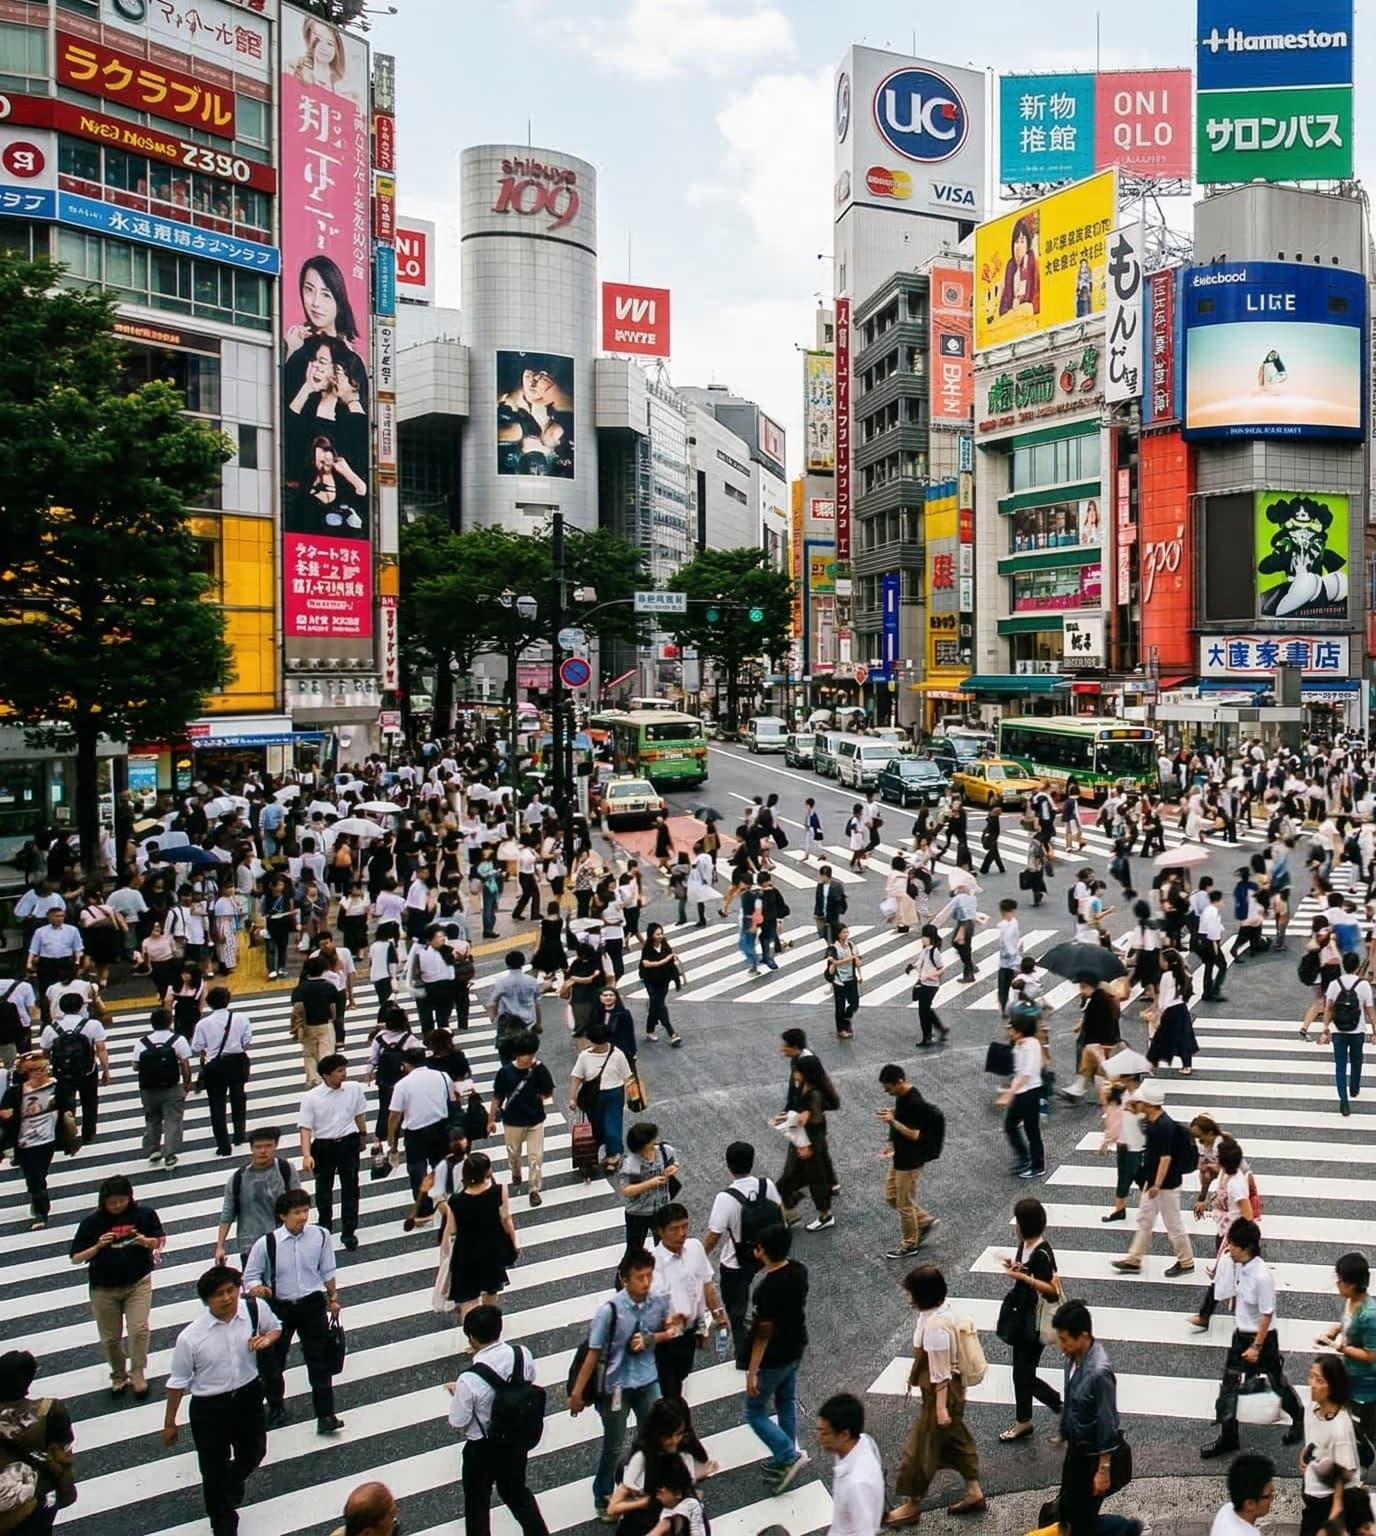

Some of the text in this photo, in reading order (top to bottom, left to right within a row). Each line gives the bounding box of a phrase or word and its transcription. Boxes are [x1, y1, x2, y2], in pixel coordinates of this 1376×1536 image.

[65, 44, 232, 127] ラクラブル
[885, 88, 957, 141] UC
[1019, 91, 1077, 121] 新物
[1113, 90, 1168, 116] ONI
[1113, 122, 1173, 150] QLO
[491, 177, 579, 230] 109
[933, 183, 976, 206] VISA
